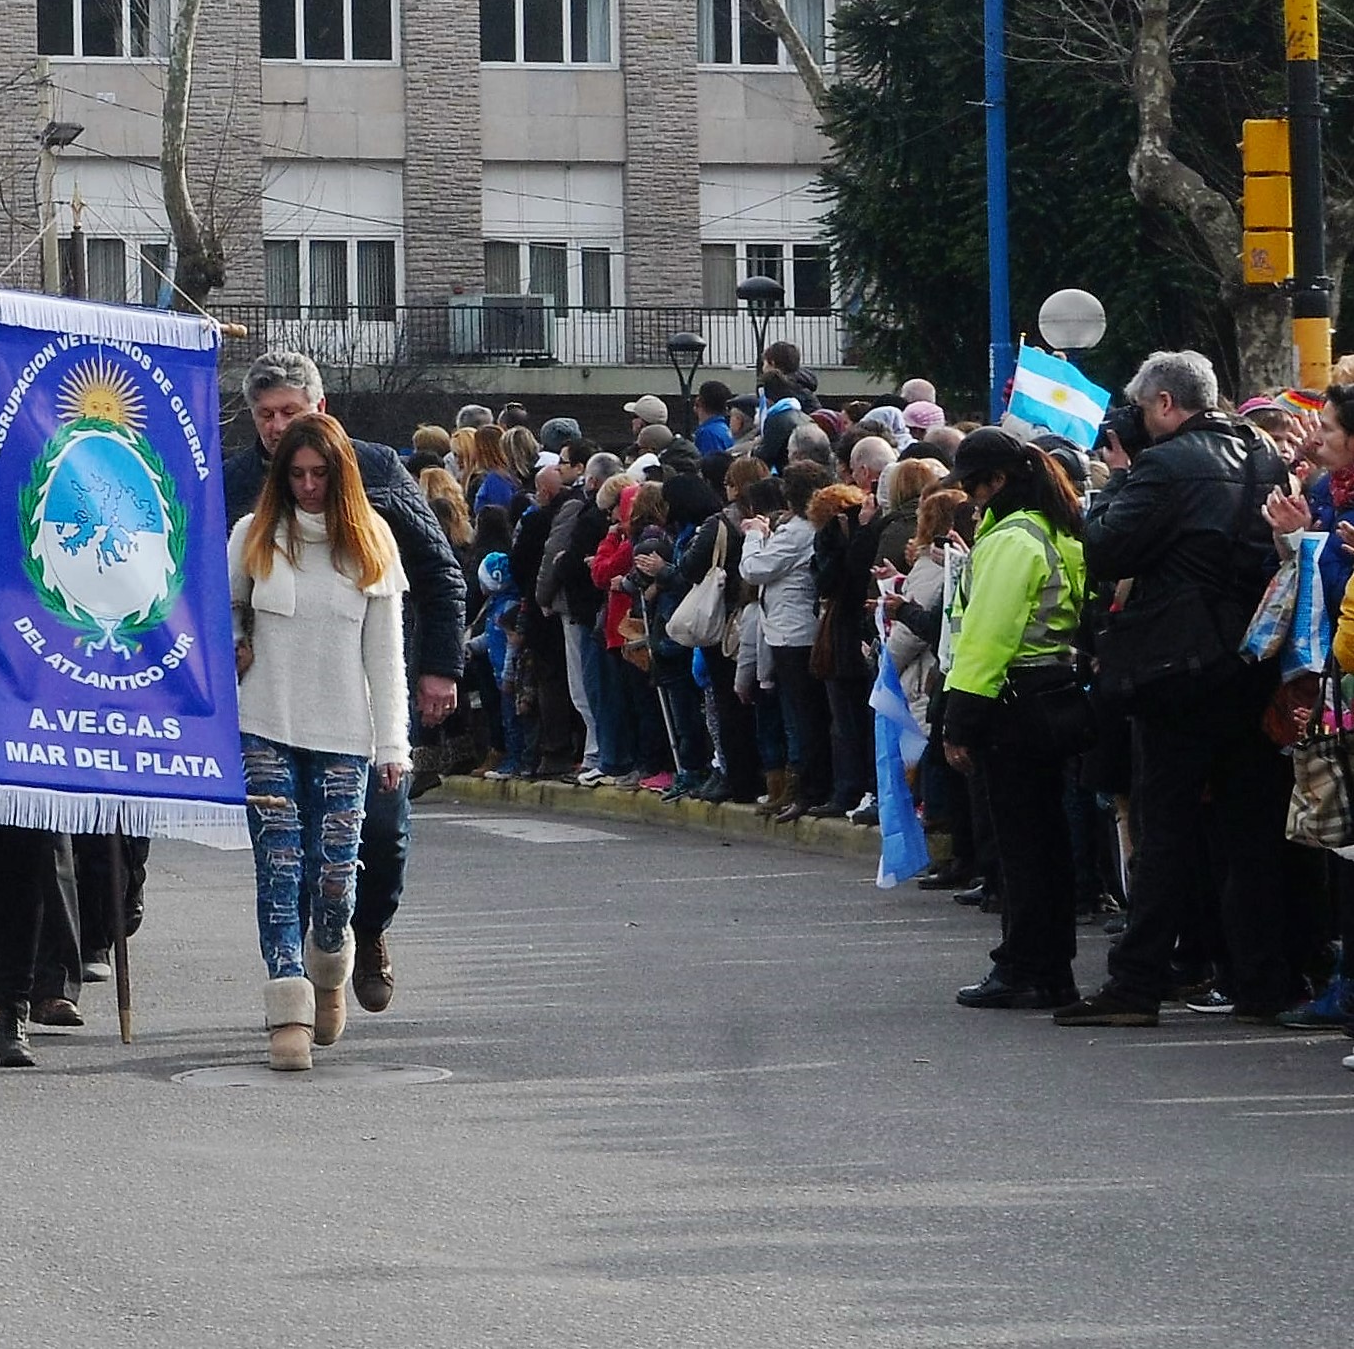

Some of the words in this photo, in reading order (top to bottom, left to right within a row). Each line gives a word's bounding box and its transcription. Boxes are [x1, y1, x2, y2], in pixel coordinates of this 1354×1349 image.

[151, 367, 174, 396] DE
[170, 395, 210, 481] GUERRA
[13, 616, 48, 655] DEL
[44, 652, 164, 691] ATLANTICO
[162, 632, 195, 670] SUR
[29, 707, 182, 740] A.VE.G.A.S
[5, 740, 69, 767] MAR
[74, 746, 128, 773] DEL
[136, 751, 223, 779] PLATA
